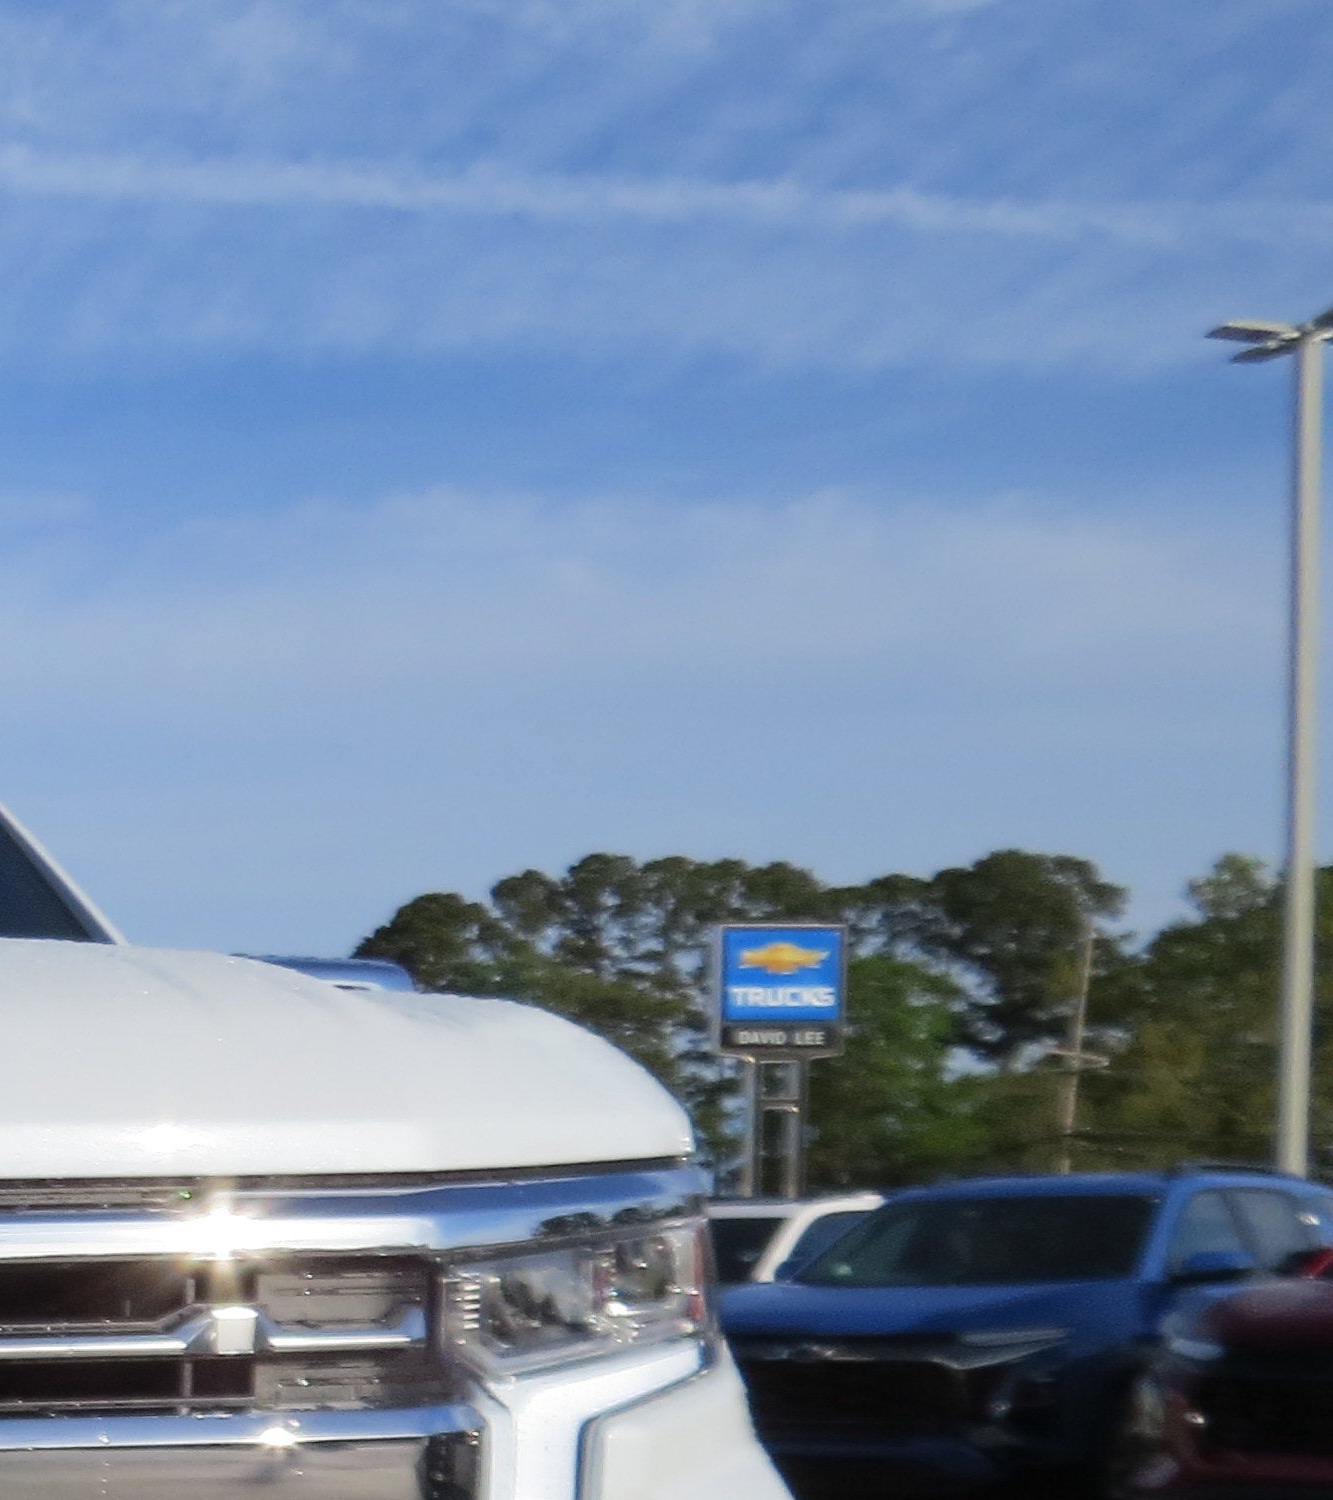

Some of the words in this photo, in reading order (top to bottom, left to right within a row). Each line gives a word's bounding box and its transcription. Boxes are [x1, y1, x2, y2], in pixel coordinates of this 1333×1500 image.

[731, 986, 835, 1007] TRUCKS
[737, 1030, 786, 1045] DAVID
[795, 1030, 825, 1045] LEE
